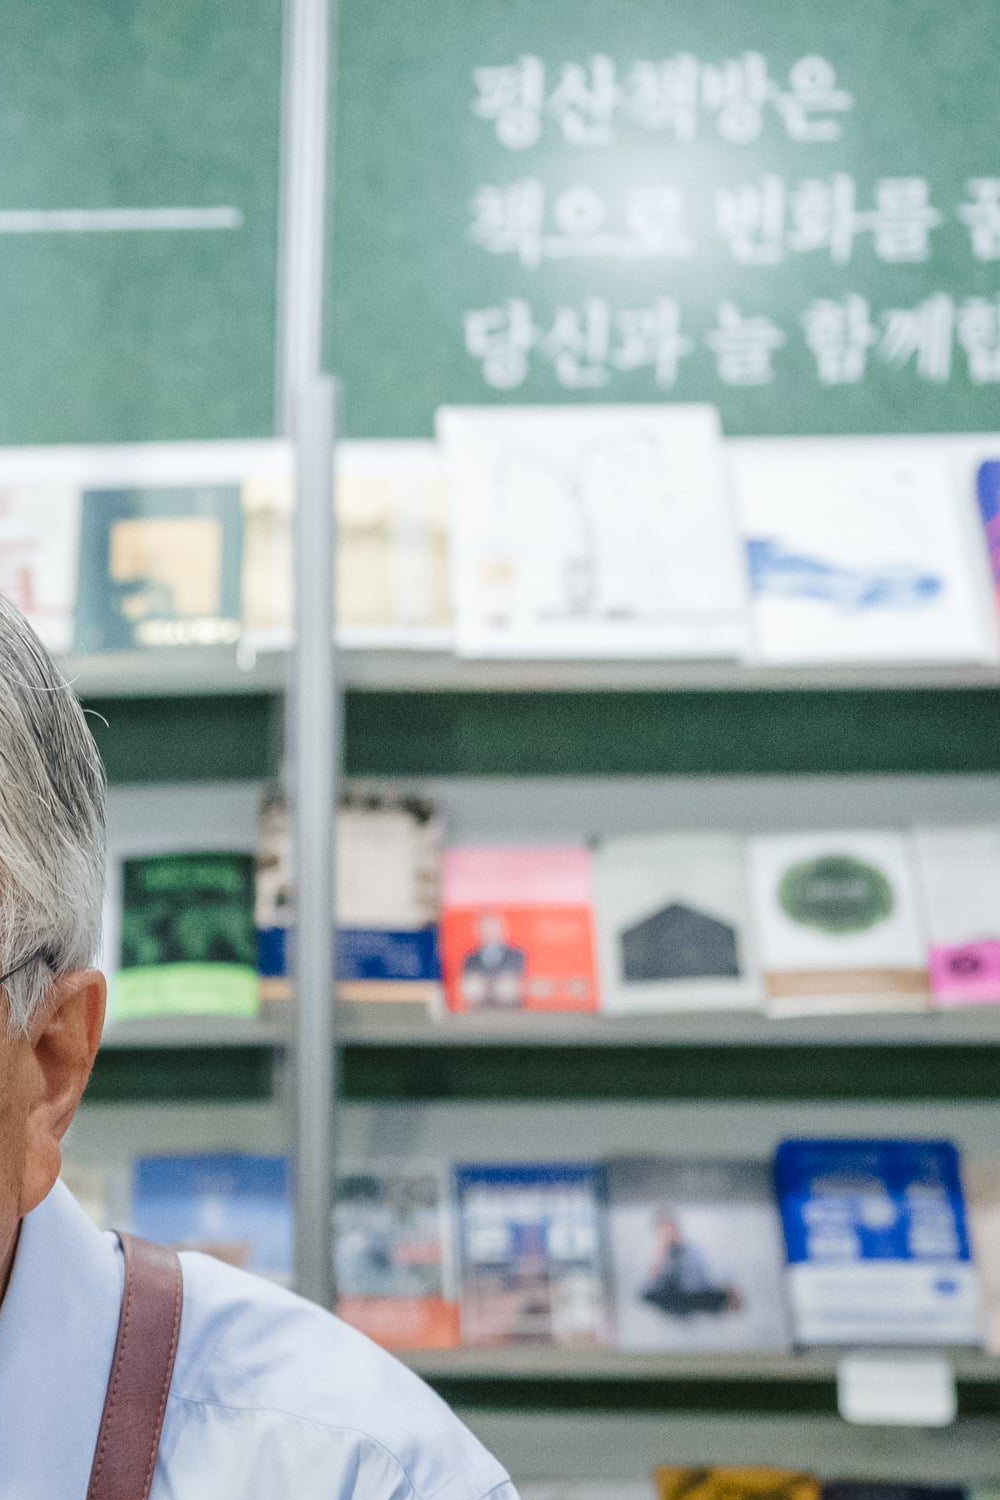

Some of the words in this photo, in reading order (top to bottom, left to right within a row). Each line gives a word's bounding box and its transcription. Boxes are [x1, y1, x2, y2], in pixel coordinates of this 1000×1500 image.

[472, 50, 854, 149] 평산책방은
[468, 176, 698, 270] 책으로
[464, 295, 694, 390] 당신과
[704, 299, 786, 387] 늘
